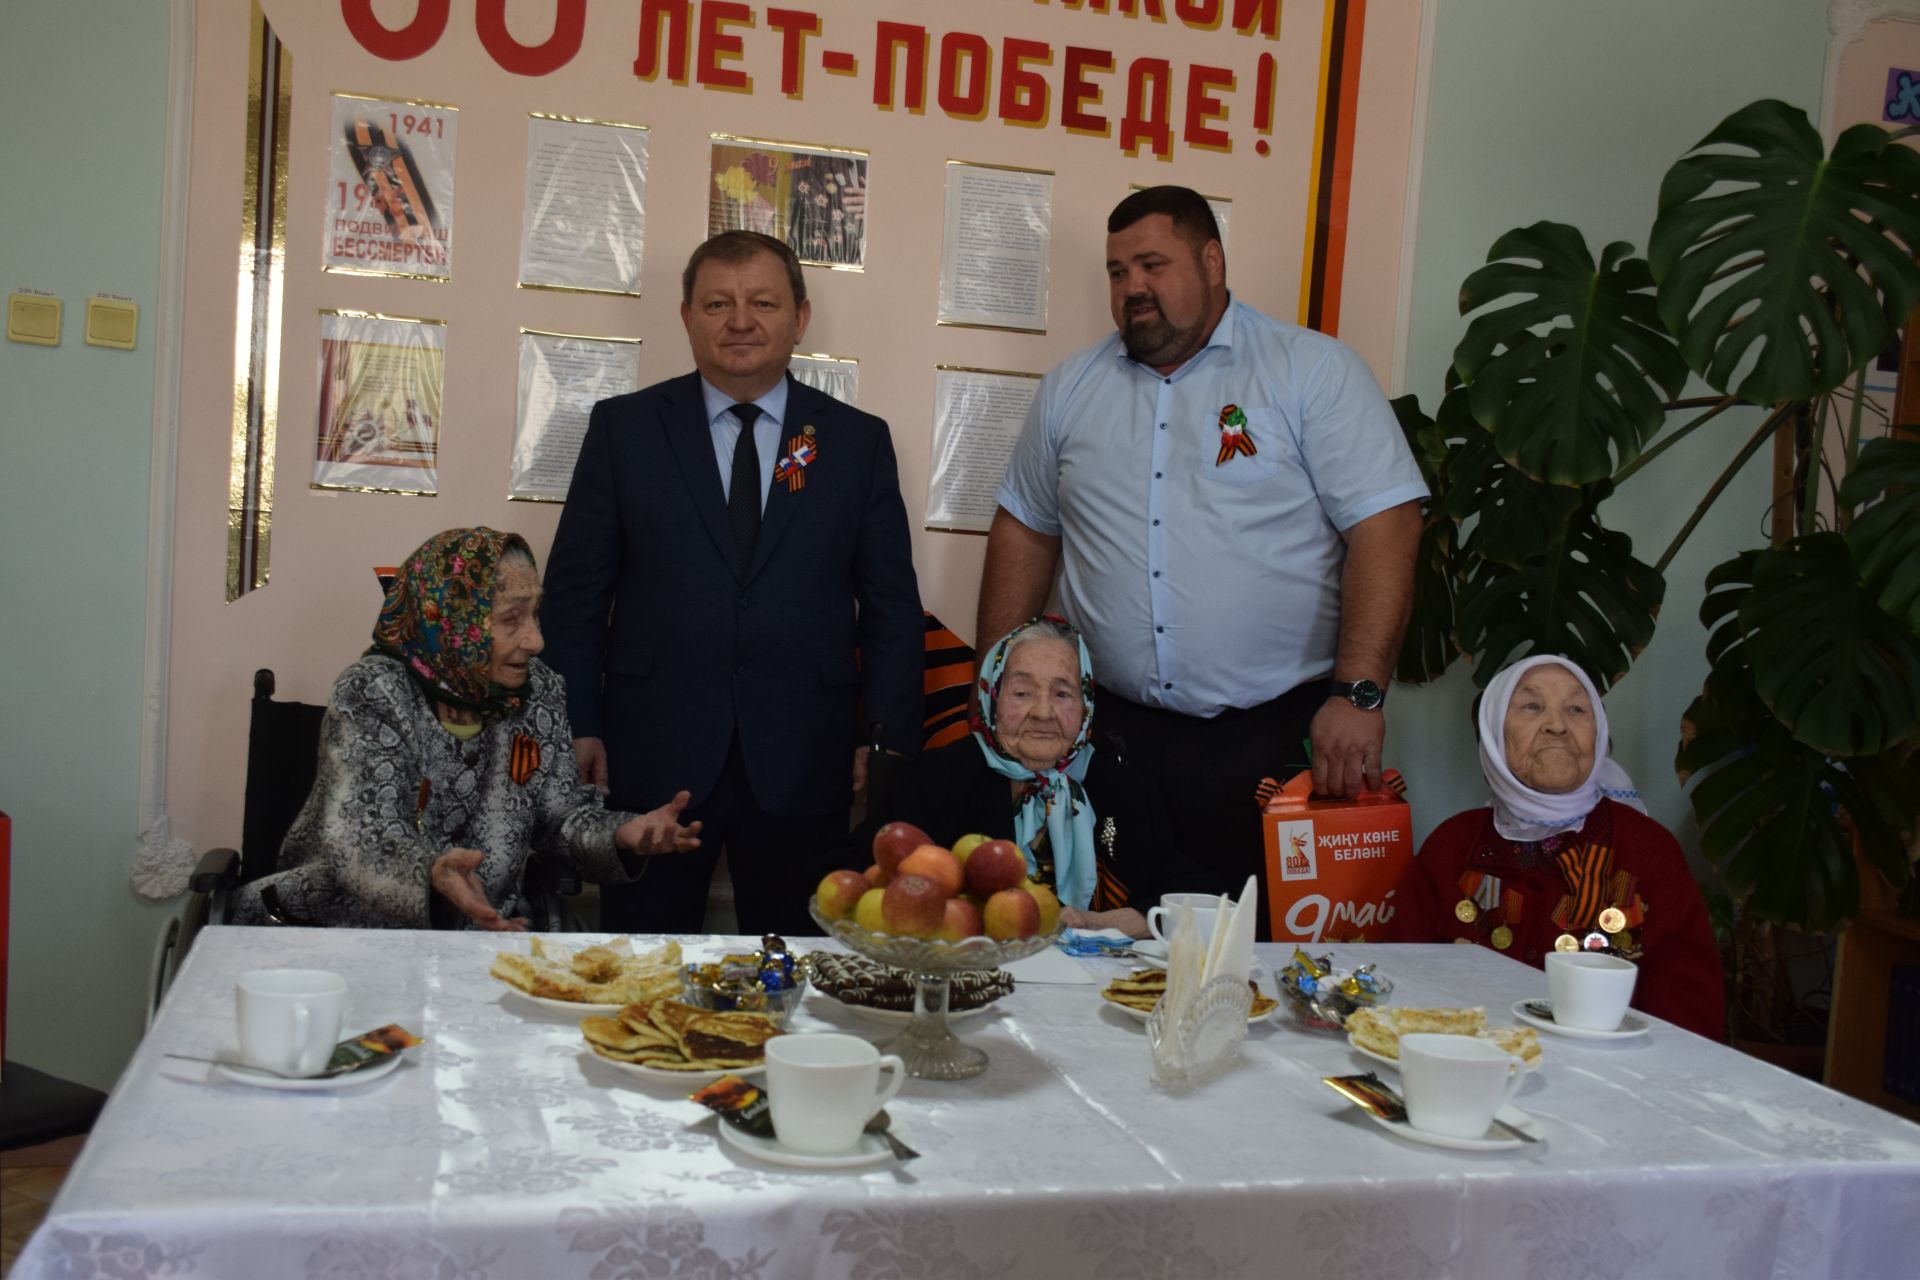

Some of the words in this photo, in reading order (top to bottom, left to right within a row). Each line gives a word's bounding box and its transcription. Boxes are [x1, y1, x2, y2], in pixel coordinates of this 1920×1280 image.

[389, 113, 444, 139] 1941
[1363, 830, 1400, 843] КӨНЕ
[1334, 847, 1387, 861] БЕЛӘН!
[1285, 894, 1331, 943] 9
